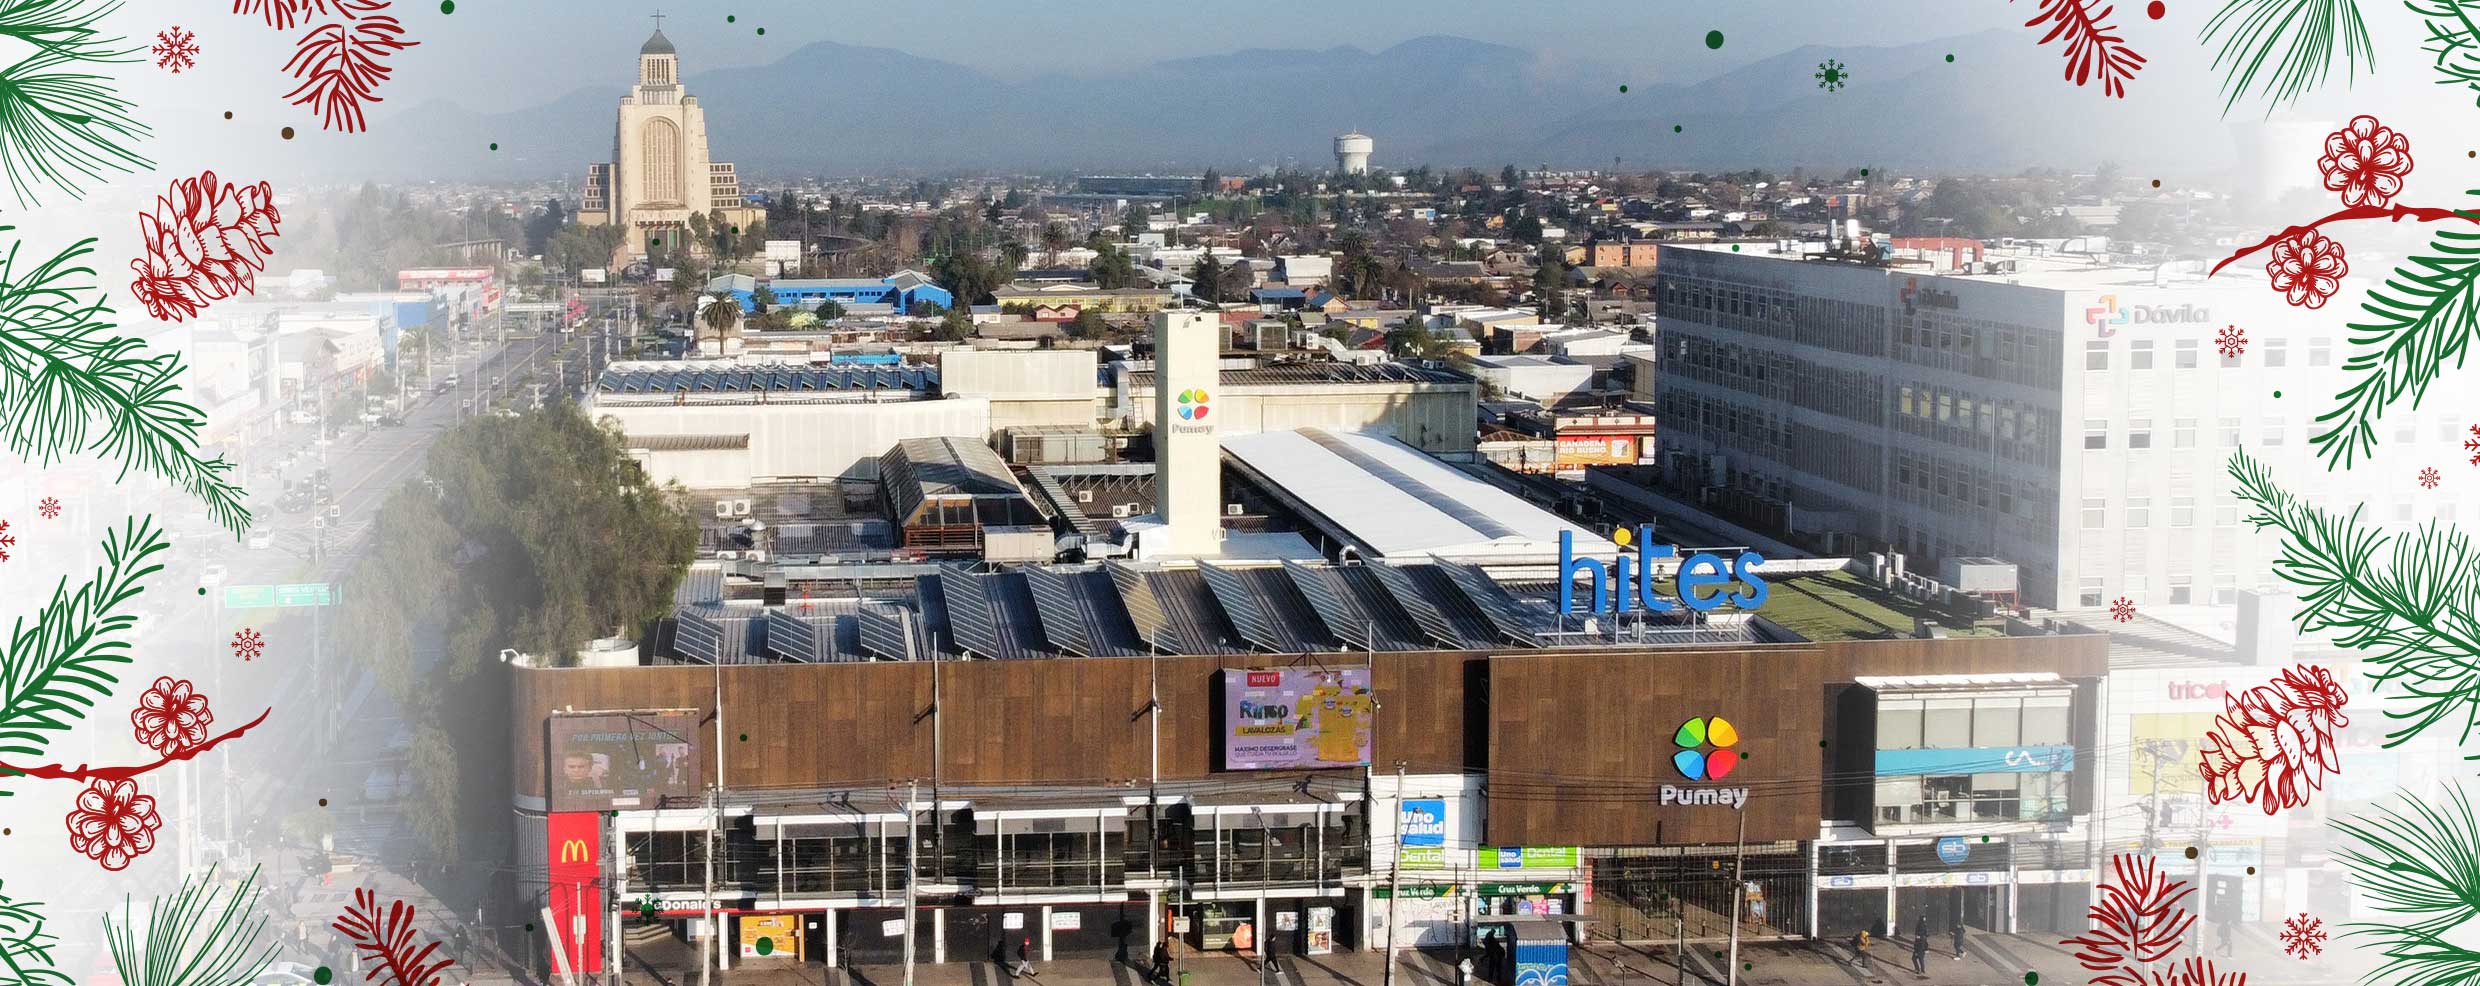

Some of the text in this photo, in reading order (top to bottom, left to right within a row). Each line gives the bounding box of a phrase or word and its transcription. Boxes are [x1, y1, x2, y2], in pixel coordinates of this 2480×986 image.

[2133, 304, 2210, 325] Dávila
[1172, 423, 1214, 435] Pumay
[1577, 446, 1607, 454] BUENO
[1559, 523, 1769, 615] hites
[1251, 675, 1276, 684] NUEVO
[2168, 679, 2230, 700] tricot
[1239, 700, 1289, 719] Rinso
[1242, 725, 1286, 734] LAVALOZAS
[1659, 783, 1749, 810] Pumay
[1400, 820, 1444, 834] salud
[1399, 849, 1445, 862] Dental
[1527, 846, 1566, 858] Dental
[1410, 887, 1435, 896] Verde
[1498, 884, 1540, 893] Cruz Verde
